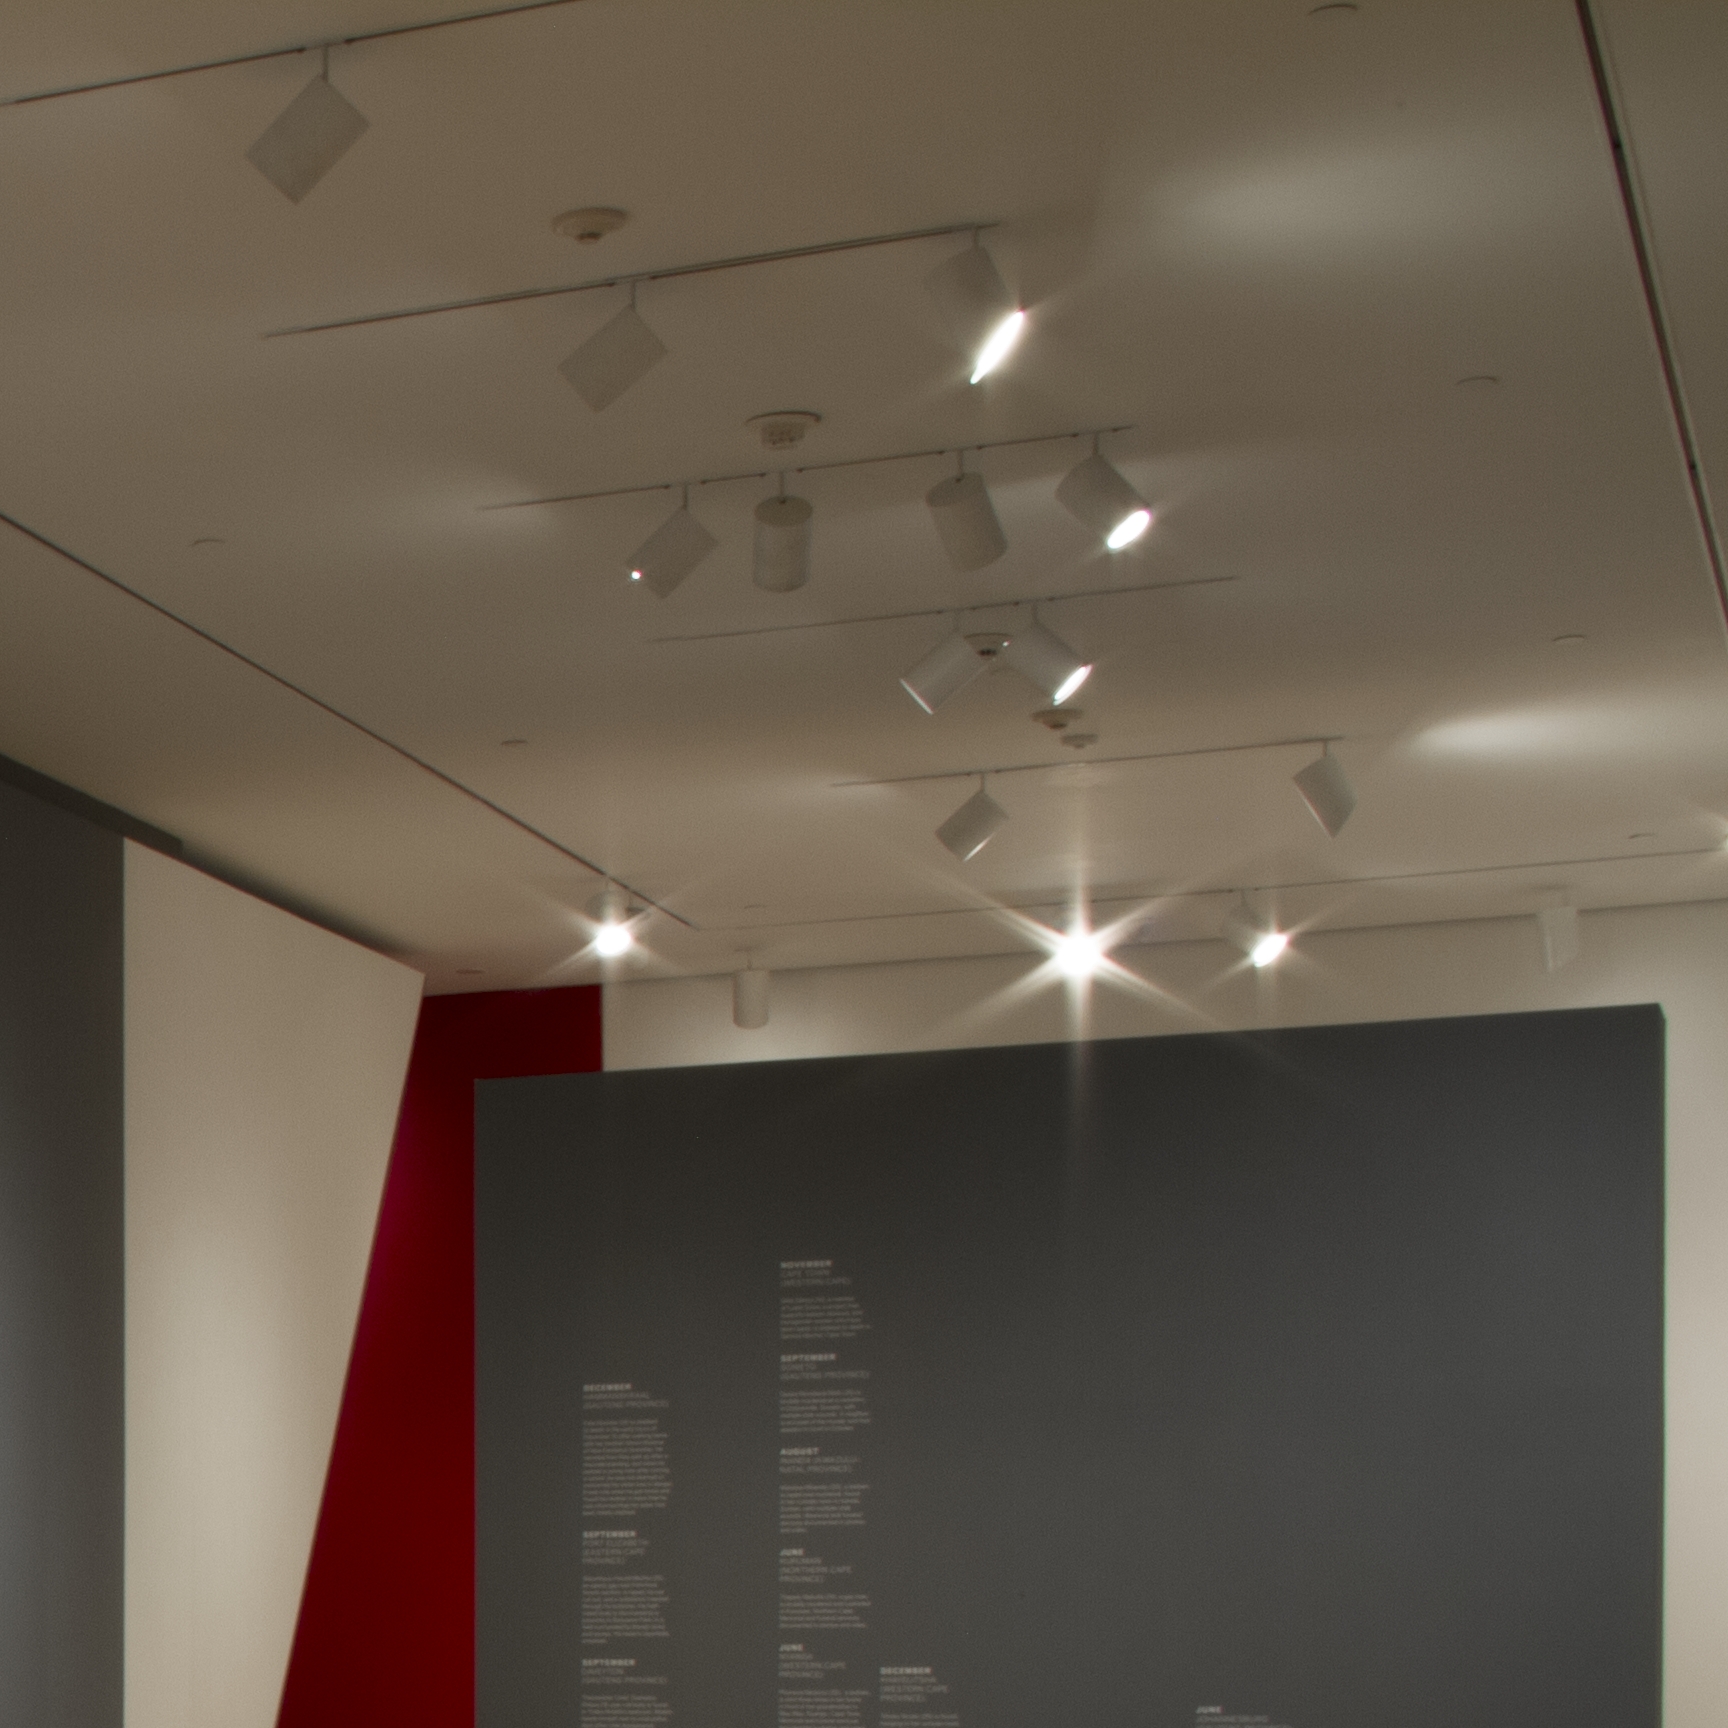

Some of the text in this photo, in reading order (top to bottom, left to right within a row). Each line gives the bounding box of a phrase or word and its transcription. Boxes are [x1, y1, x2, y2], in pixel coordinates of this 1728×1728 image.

[780, 1259, 832, 1269] NOVEMBER
[780, 1352, 836, 1361] SEPTEMBER
[780, 1447, 818, 1455] AUGUST
[583, 1529, 636, 1538] SEPTEMBER
